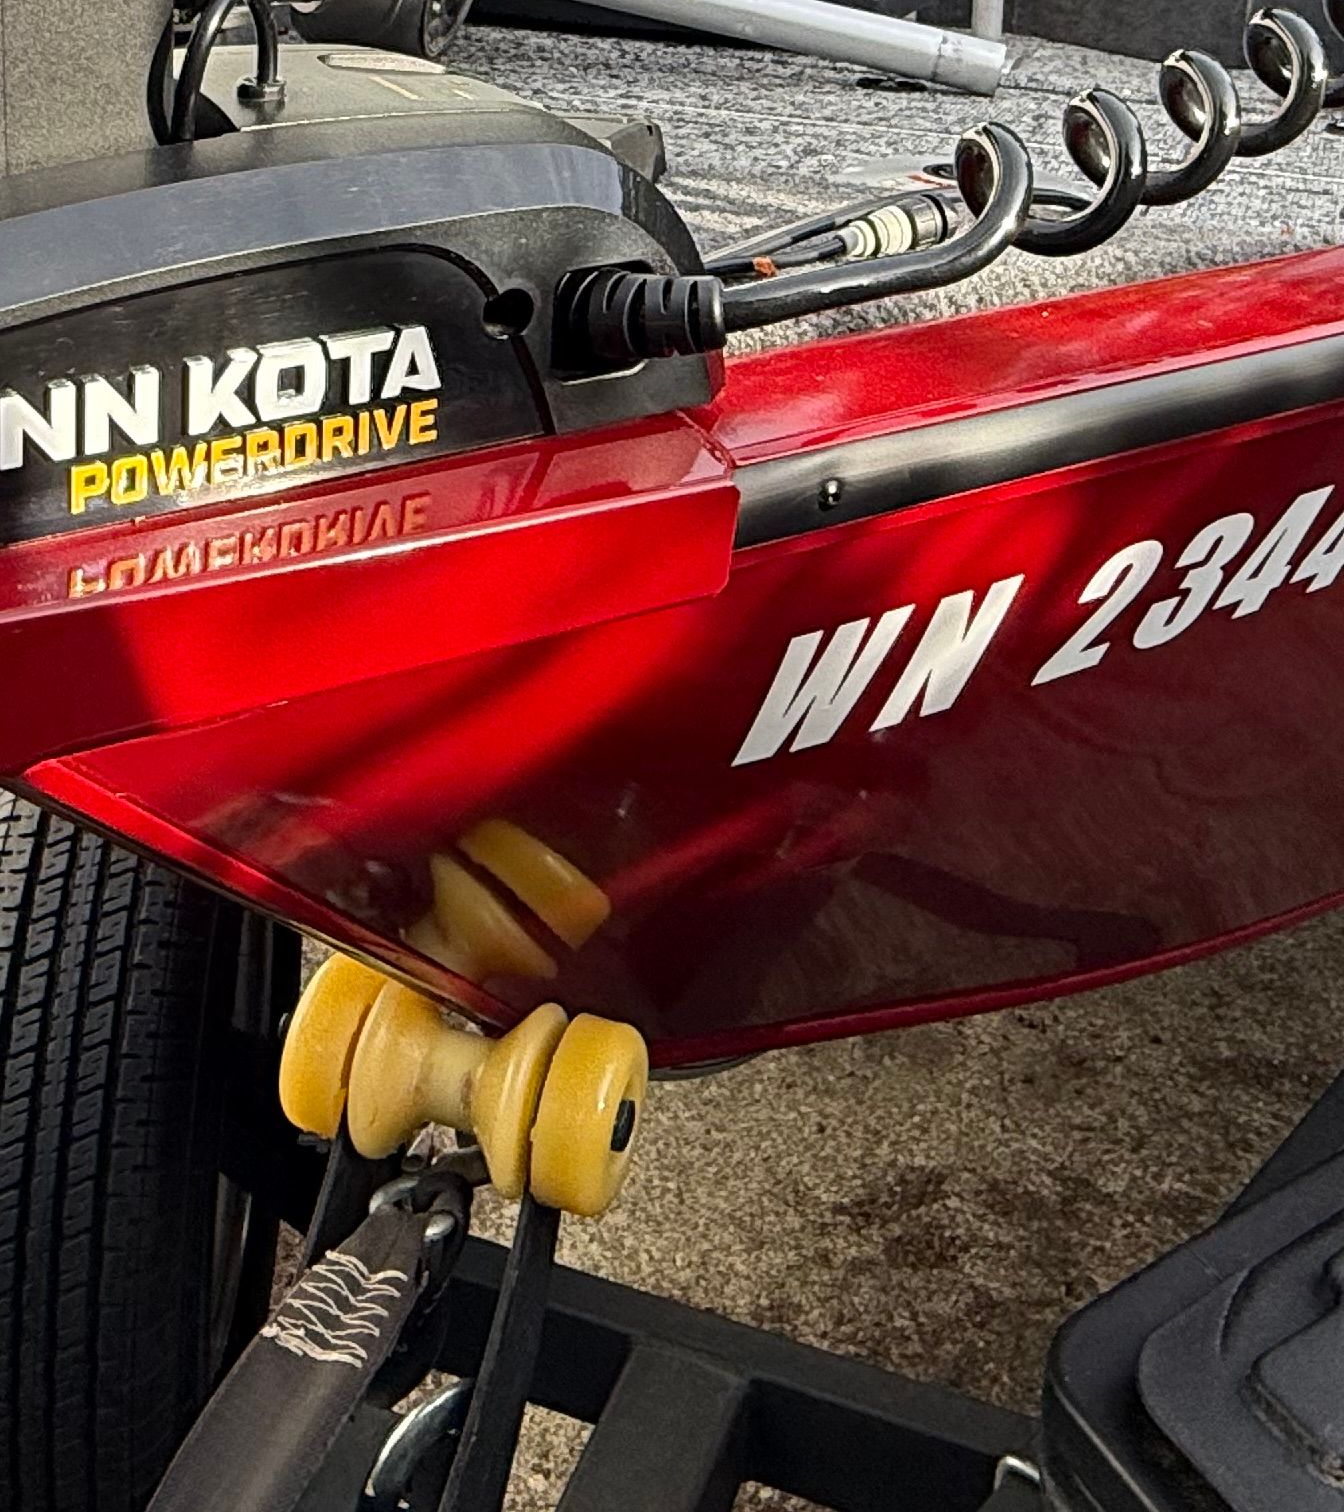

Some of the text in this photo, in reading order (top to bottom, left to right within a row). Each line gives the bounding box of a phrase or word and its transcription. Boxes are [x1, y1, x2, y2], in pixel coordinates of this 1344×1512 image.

[183, 324, 442, 436] KOTA
[69, 398, 439, 515] POWERDRIVE
[732, 575, 1024, 767] WN
